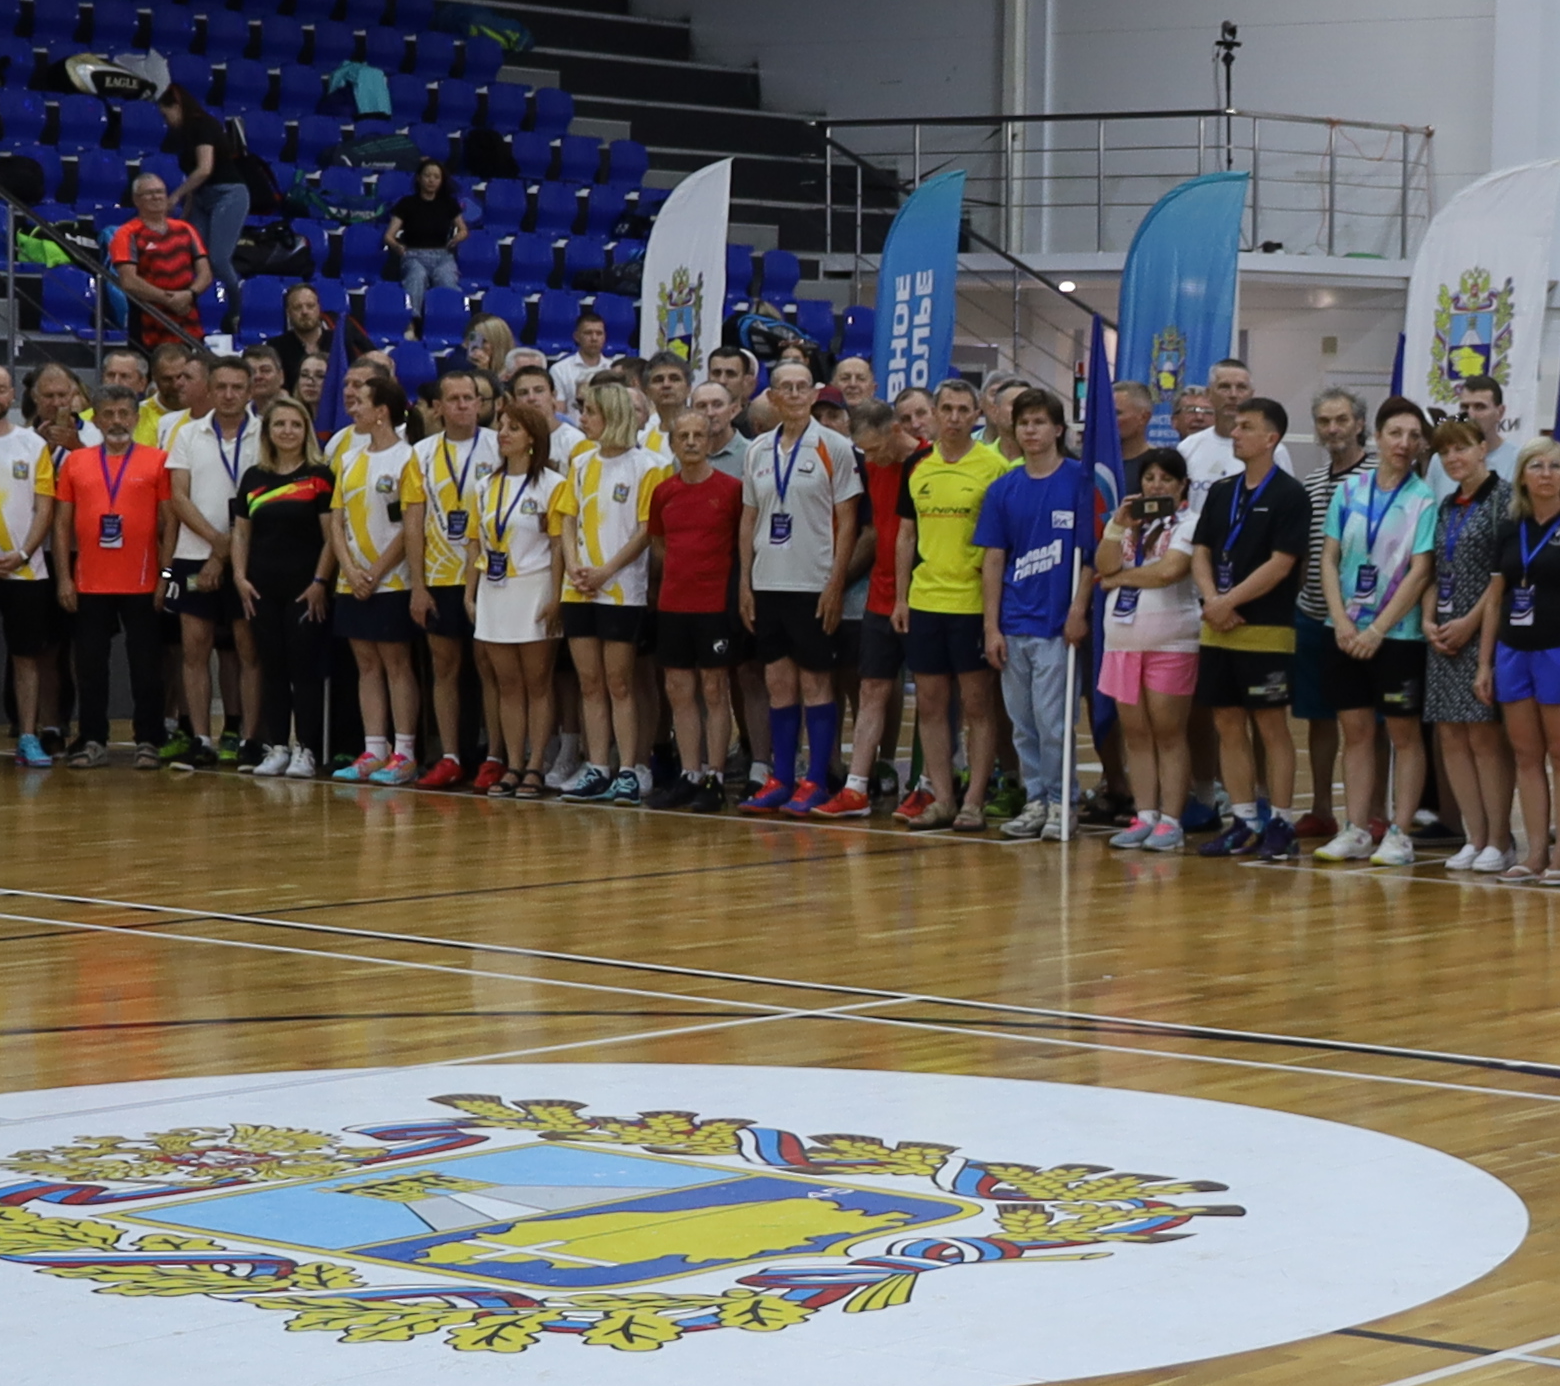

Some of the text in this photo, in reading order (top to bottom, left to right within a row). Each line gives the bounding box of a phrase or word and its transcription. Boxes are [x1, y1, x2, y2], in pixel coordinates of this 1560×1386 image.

[104, 76, 138, 89] EAGLE
[887, 274, 911, 403] ВНОЕ
[910, 269, 934, 389] ОЛЬЕ
